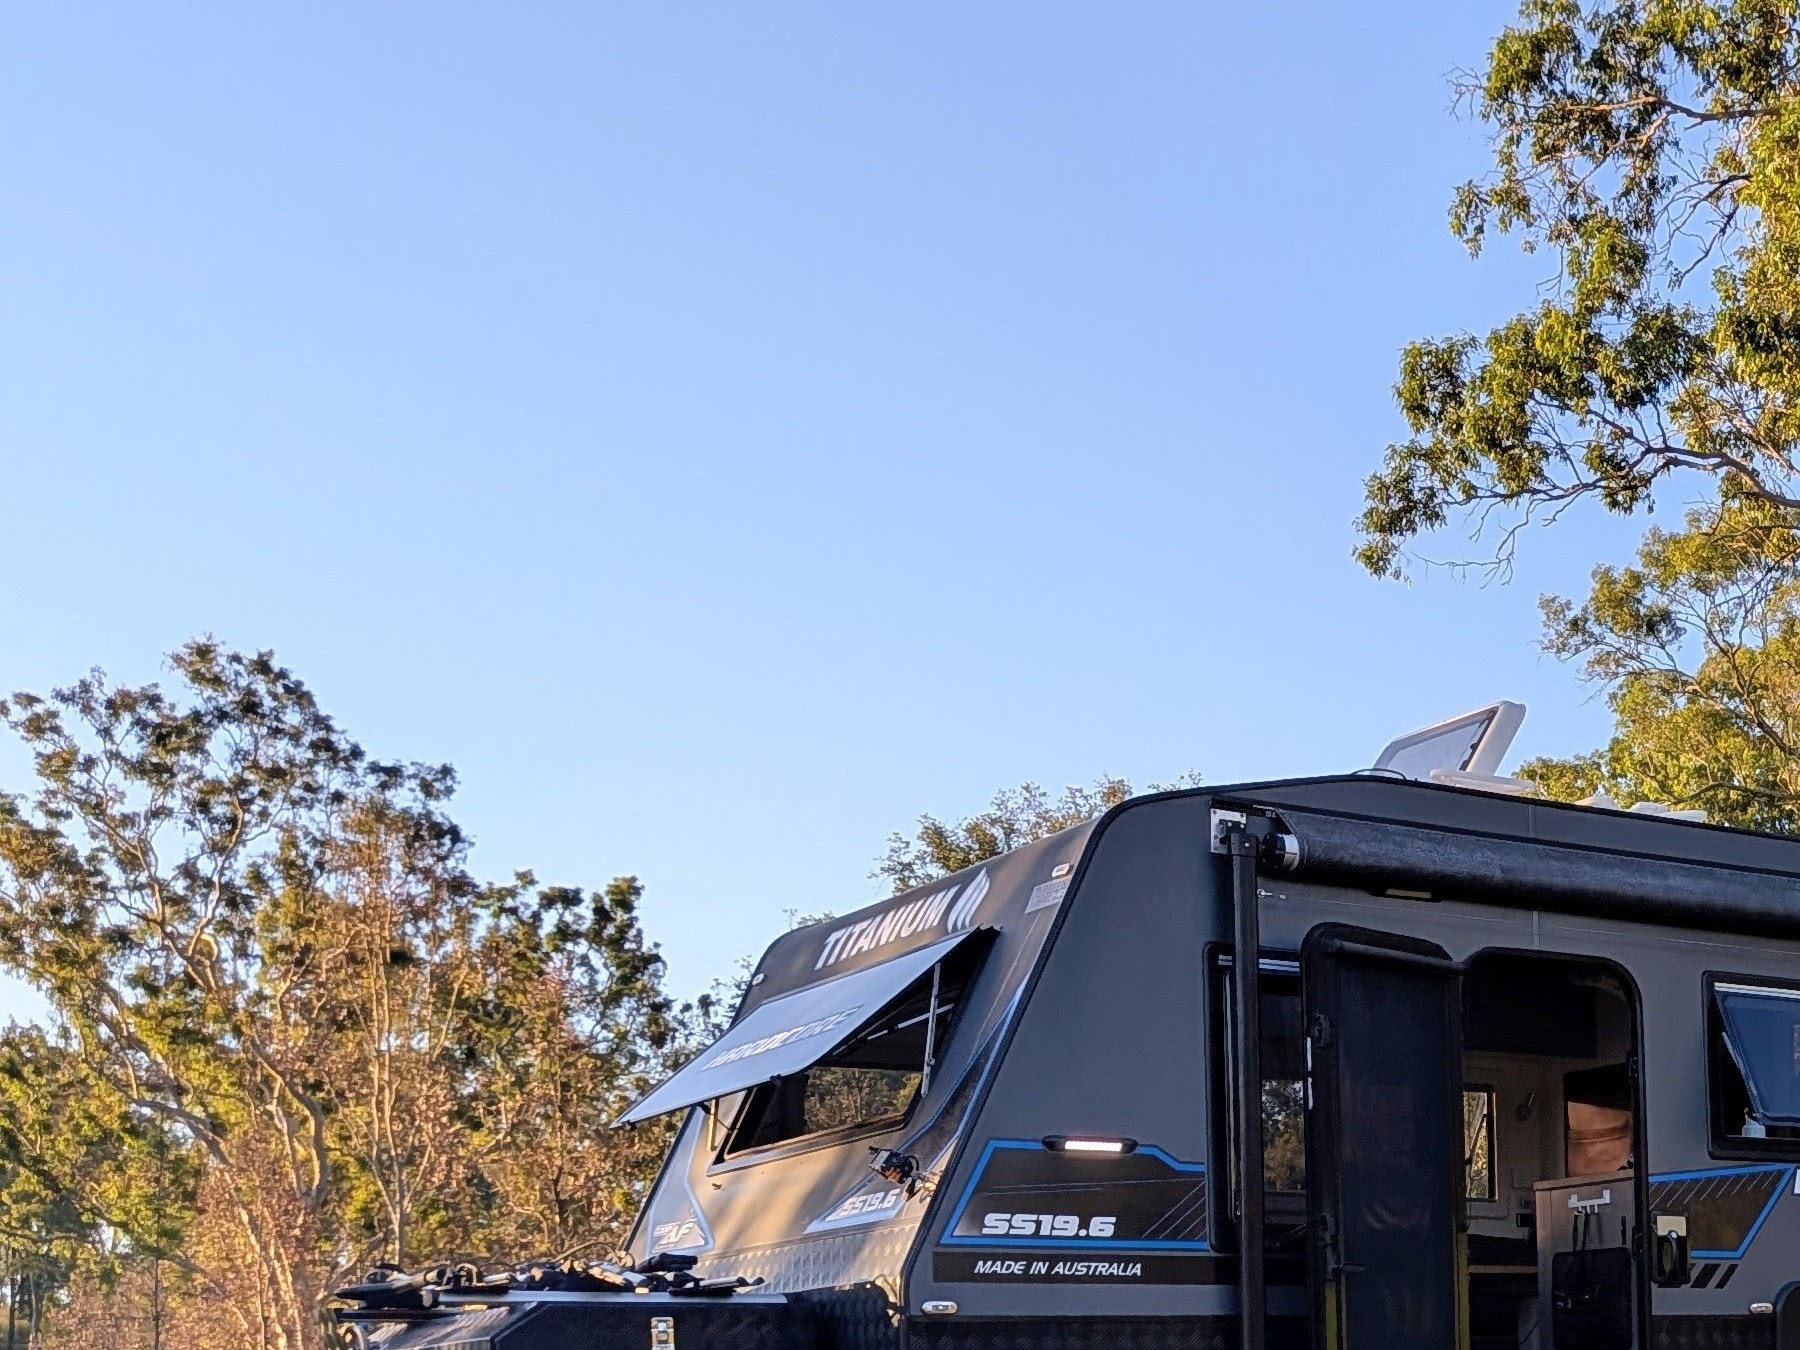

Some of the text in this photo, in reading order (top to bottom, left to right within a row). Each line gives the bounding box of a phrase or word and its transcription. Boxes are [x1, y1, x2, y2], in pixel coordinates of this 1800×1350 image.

[814, 884, 962, 971] TITANIUM
[699, 1004, 864, 1072] HARDCORE
[841, 1188, 901, 1217] SS19.6
[981, 1212, 1117, 1238] SS19.6
[974, 1260, 1142, 1277] MADE IN AUSTRALIA
